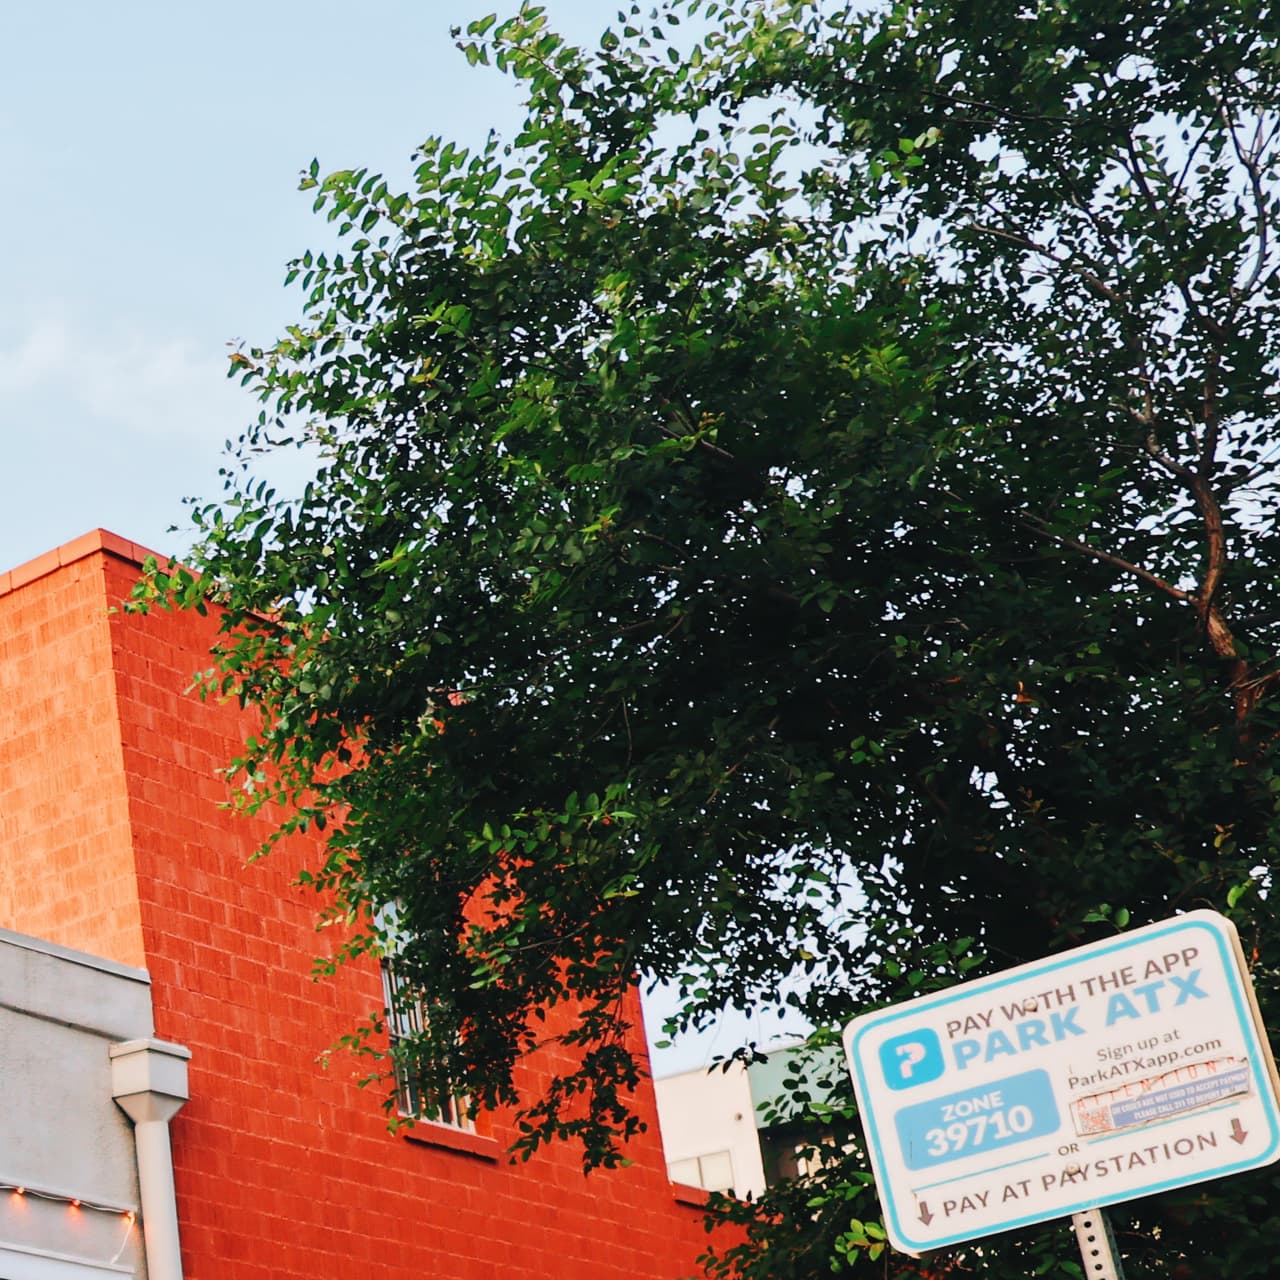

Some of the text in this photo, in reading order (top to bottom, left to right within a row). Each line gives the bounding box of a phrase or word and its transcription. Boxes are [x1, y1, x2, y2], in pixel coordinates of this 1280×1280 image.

[946, 947, 1199, 1039] PAY WTH THE APP
[952, 1006, 1087, 1071] PARK
[1105, 968, 1210, 1027] ATX
[1096, 1028, 1181, 1063] Sign up at
[1068, 1037, 1222, 1090] ParkATXapp.com
[924, 1105, 1033, 1157] 39710
[940, 1090, 1004, 1122] ZONE
[943, 1131, 1218, 1217] PAY AT PAYSTATION
[1058, 1143, 1080, 1157] OR
